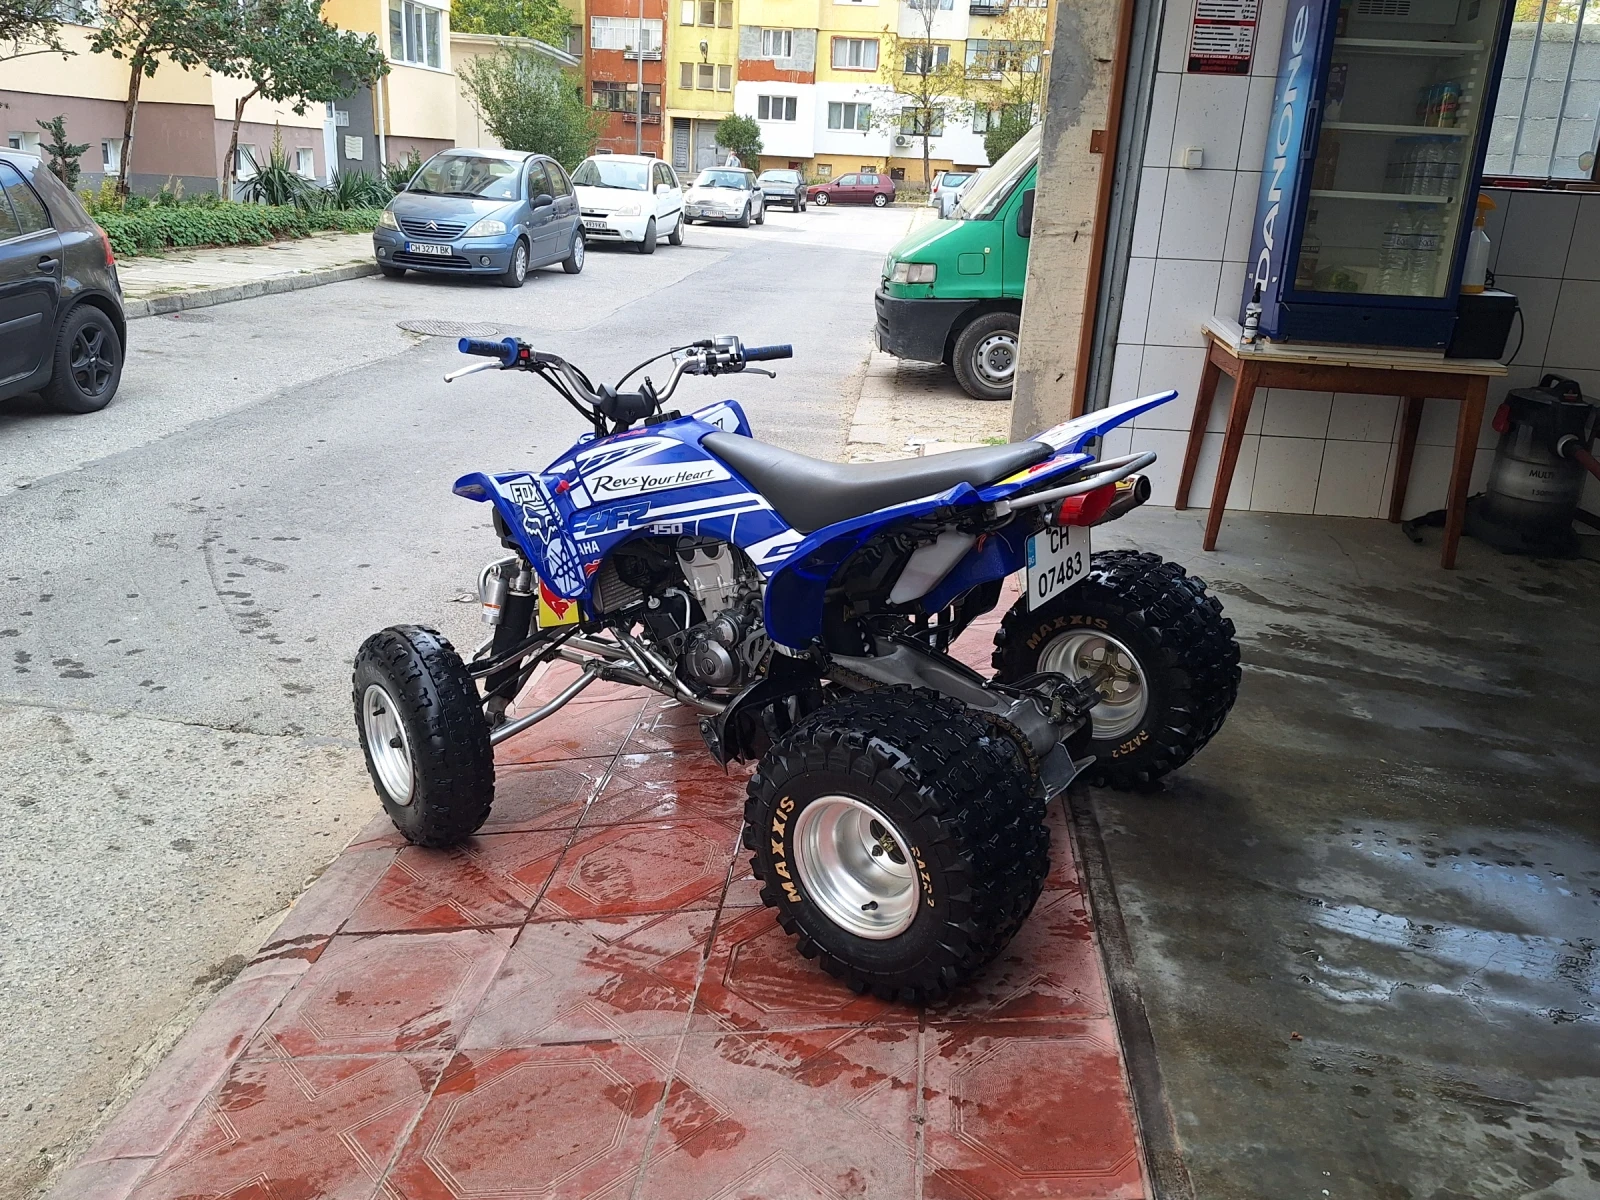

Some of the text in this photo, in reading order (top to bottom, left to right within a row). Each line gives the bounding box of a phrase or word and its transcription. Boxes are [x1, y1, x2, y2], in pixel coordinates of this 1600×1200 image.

[511, 483, 541, 503] FOX
[1049, 527, 1070, 554] CH
[1038, 551, 1082, 598] 07483
[1026, 614, 1109, 650] MAXXIS
[771, 795, 802, 903] MAXXIS
